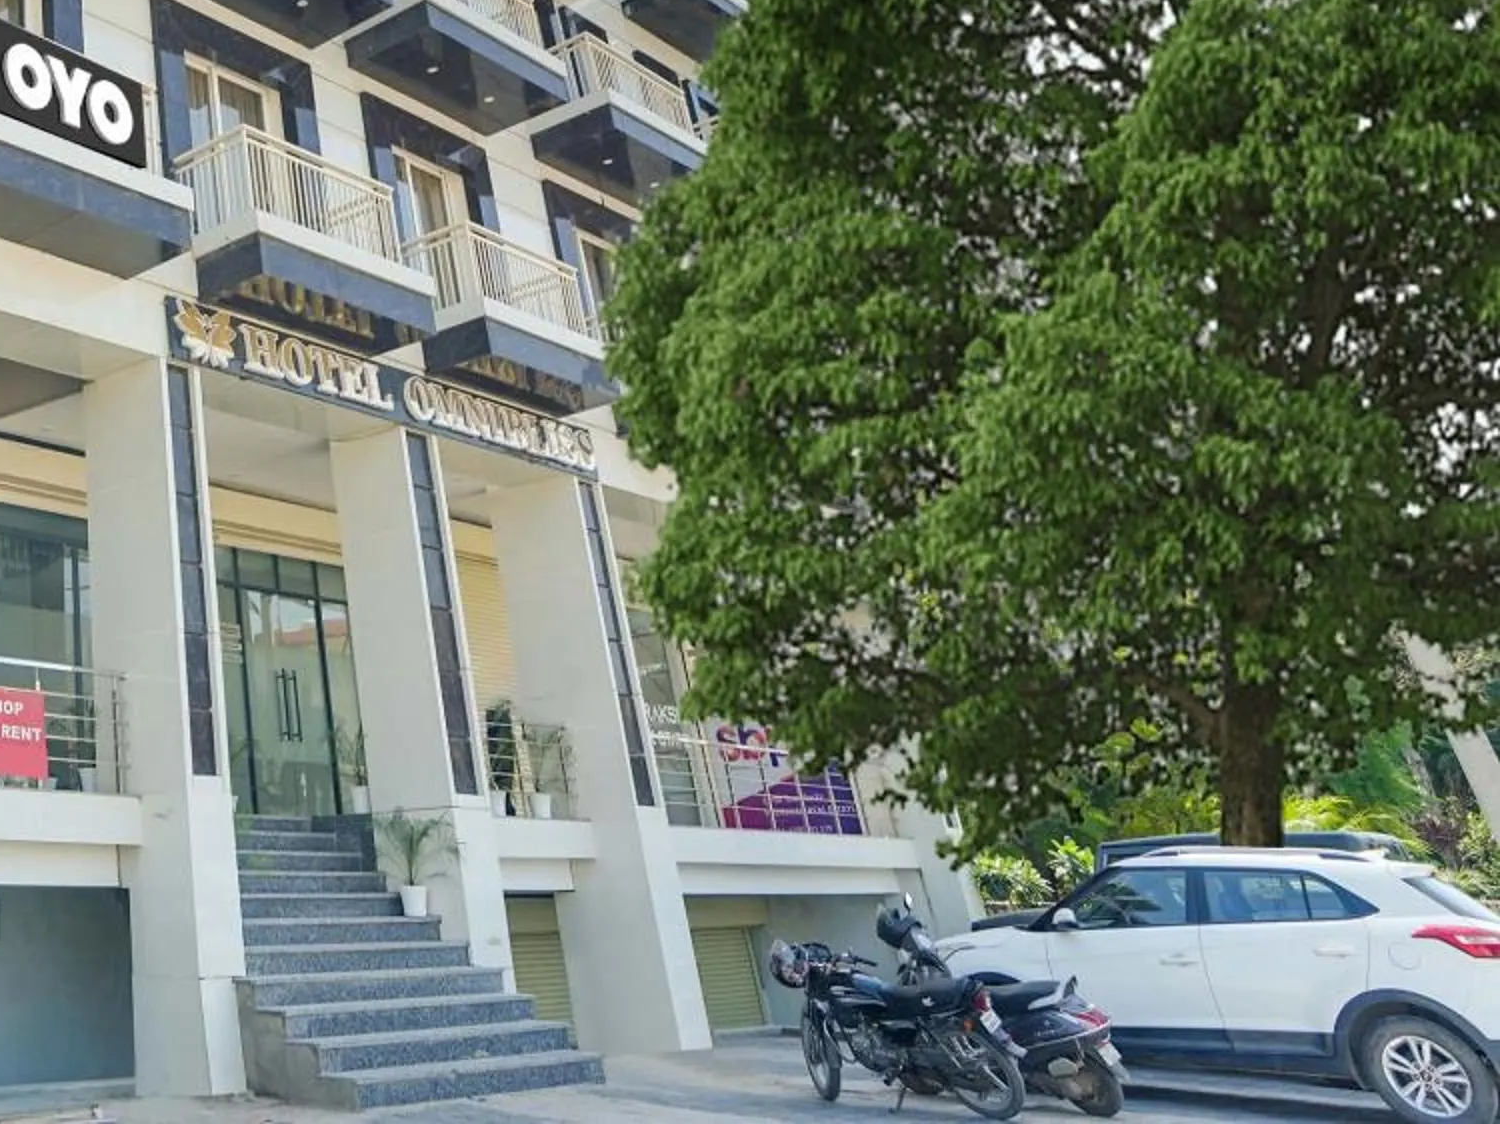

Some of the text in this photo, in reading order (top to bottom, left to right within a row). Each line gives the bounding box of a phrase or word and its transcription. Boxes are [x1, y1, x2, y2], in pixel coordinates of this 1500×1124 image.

[2, 42, 133, 145] OYO
[240, 322, 395, 412] HOTEL
[1, 723, 43, 743] RENT
